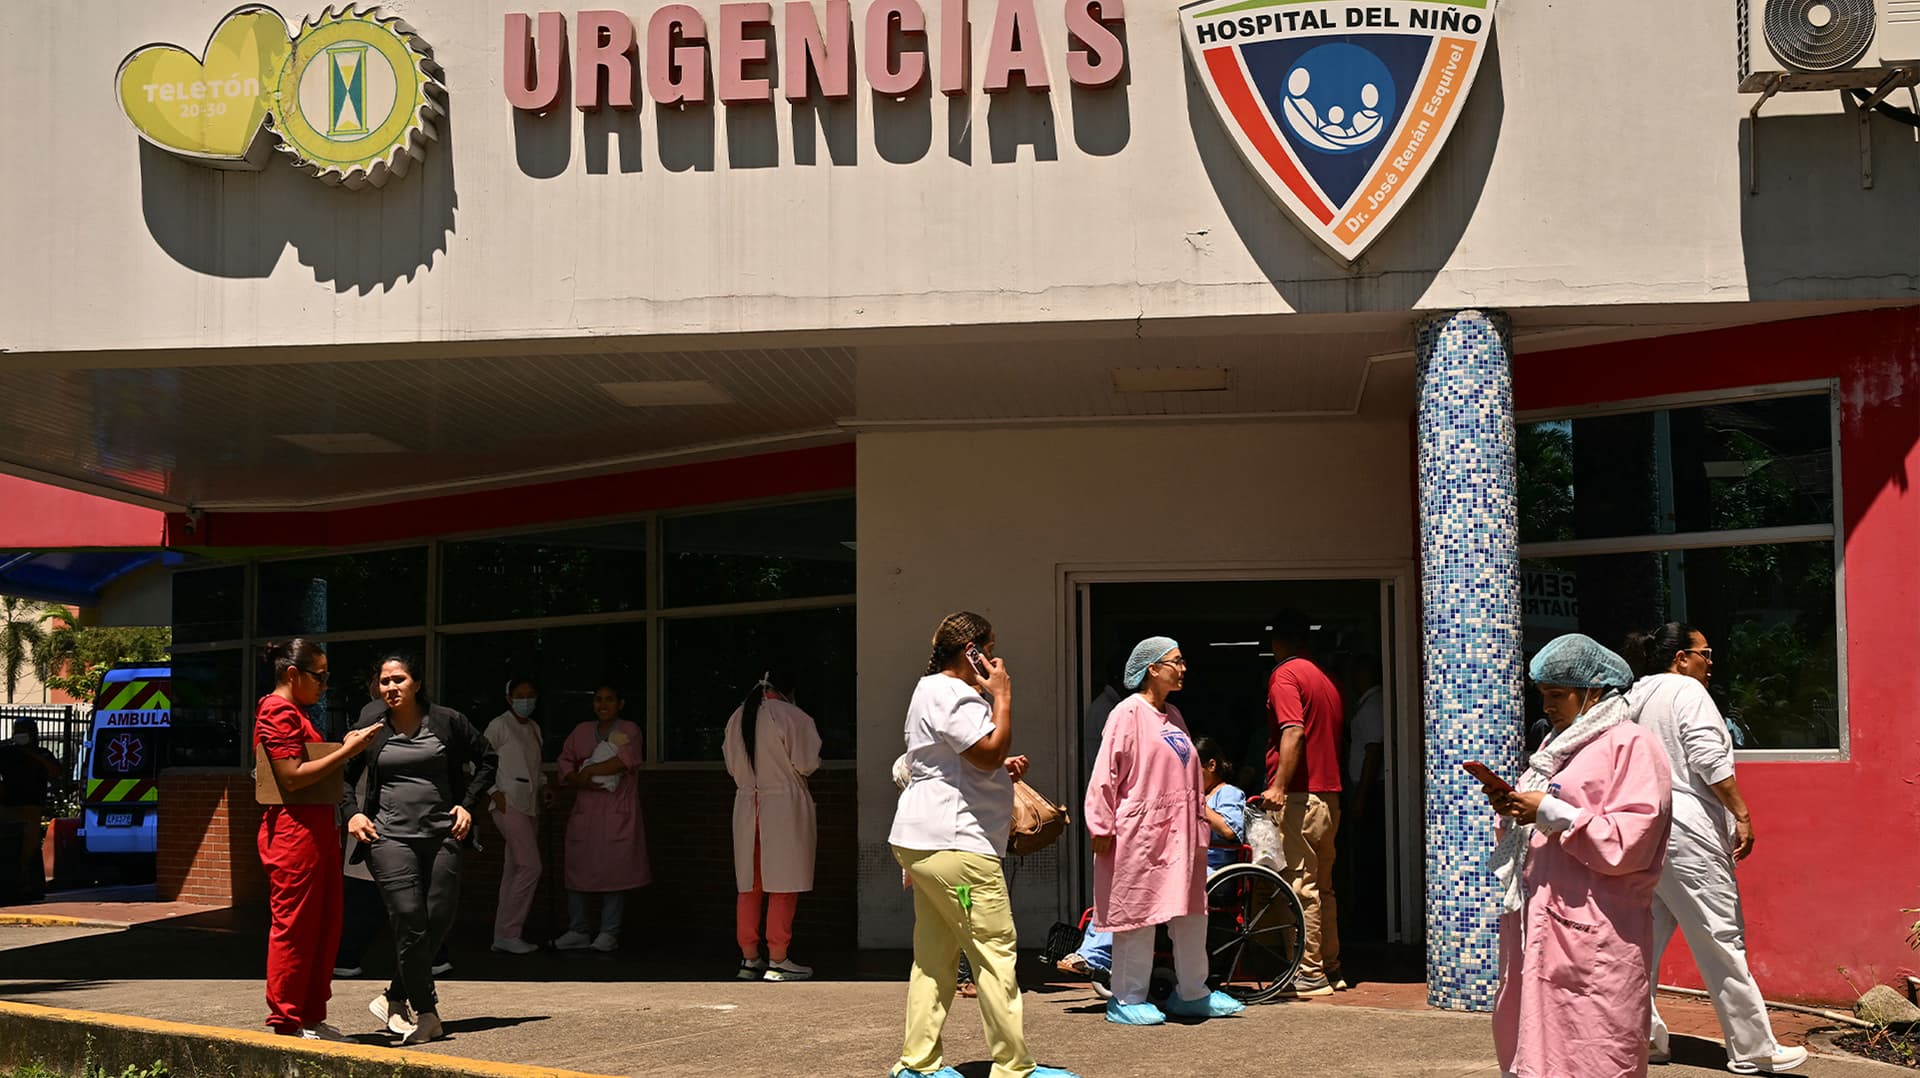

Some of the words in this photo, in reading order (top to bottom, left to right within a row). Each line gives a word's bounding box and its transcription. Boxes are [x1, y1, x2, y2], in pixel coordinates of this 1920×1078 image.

[1196, 8, 1337, 44] HOSPITAL
[1345, 7, 1400, 28] DEL
[1408, 7, 1482, 35] NIÑO
[503, 0, 1126, 110] URGENCIAS
[180, 103, 227, 118] 20-30
[1344, 212, 1370, 234] Dr.
[1366, 172, 1399, 210] José
[1392, 119, 1431, 173] Renán
[1422, 44, 1465, 118] Esquivel
[107, 712, 171, 726] AMBULA
